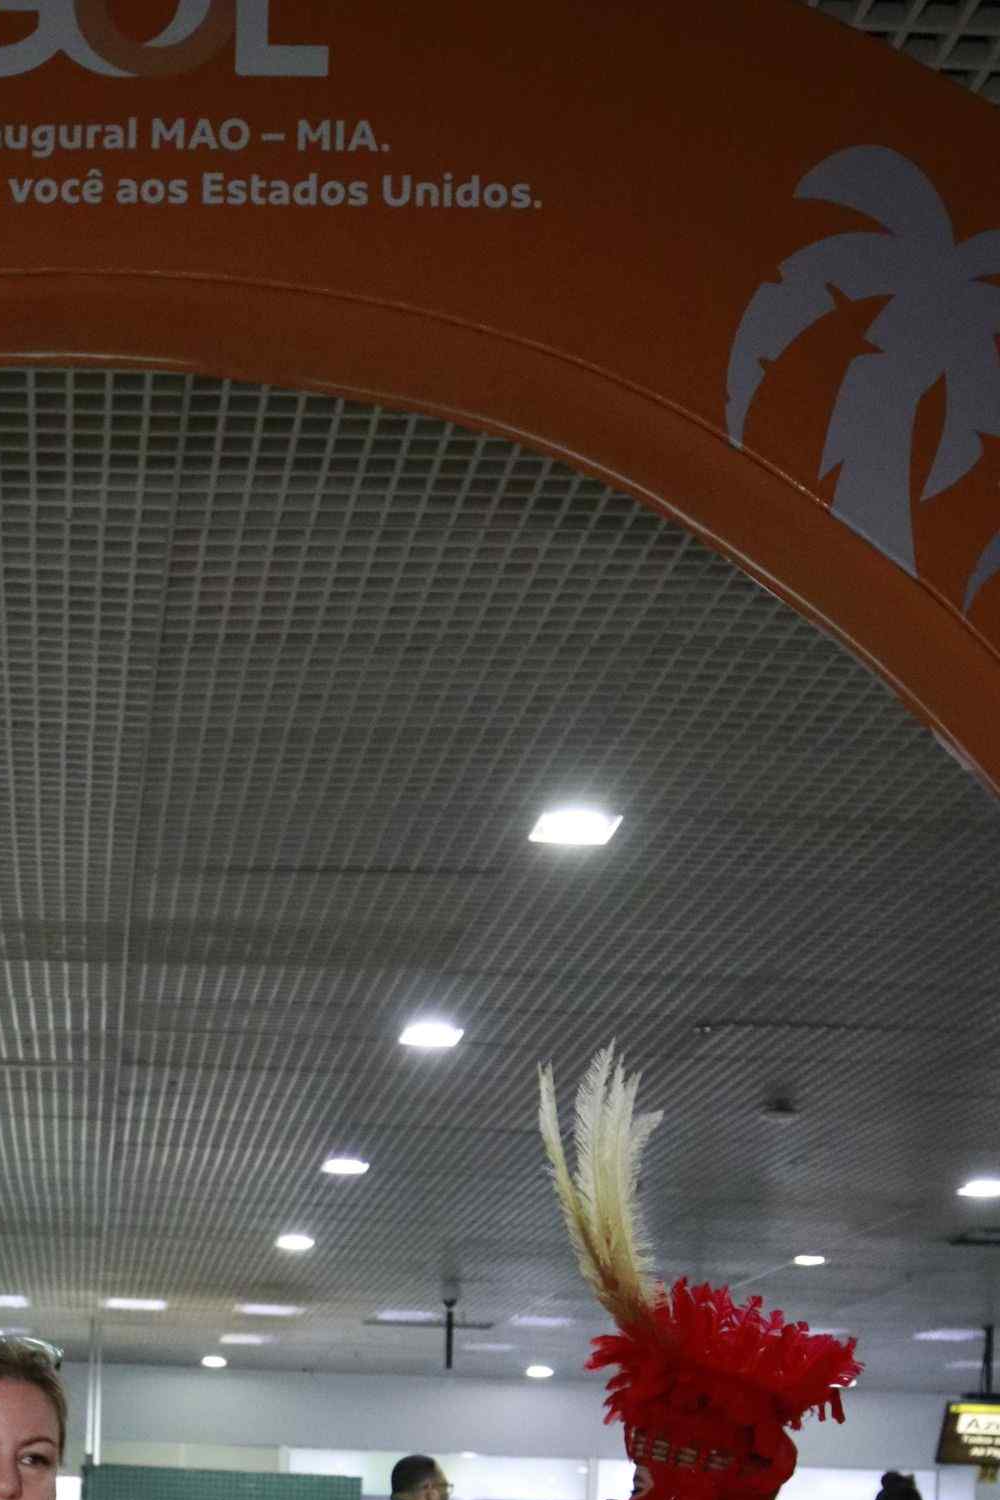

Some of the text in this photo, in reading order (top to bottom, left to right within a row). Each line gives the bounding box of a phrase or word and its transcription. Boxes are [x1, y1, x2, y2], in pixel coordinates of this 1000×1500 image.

[151, 118, 250, 151] MAO
[296, 120, 390, 152] MIA.
[8, 170, 105, 205] você
[116, 179, 189, 205] aos
[201, 173, 368, 207] Estados
[382, 174, 542, 209] Unidos.
